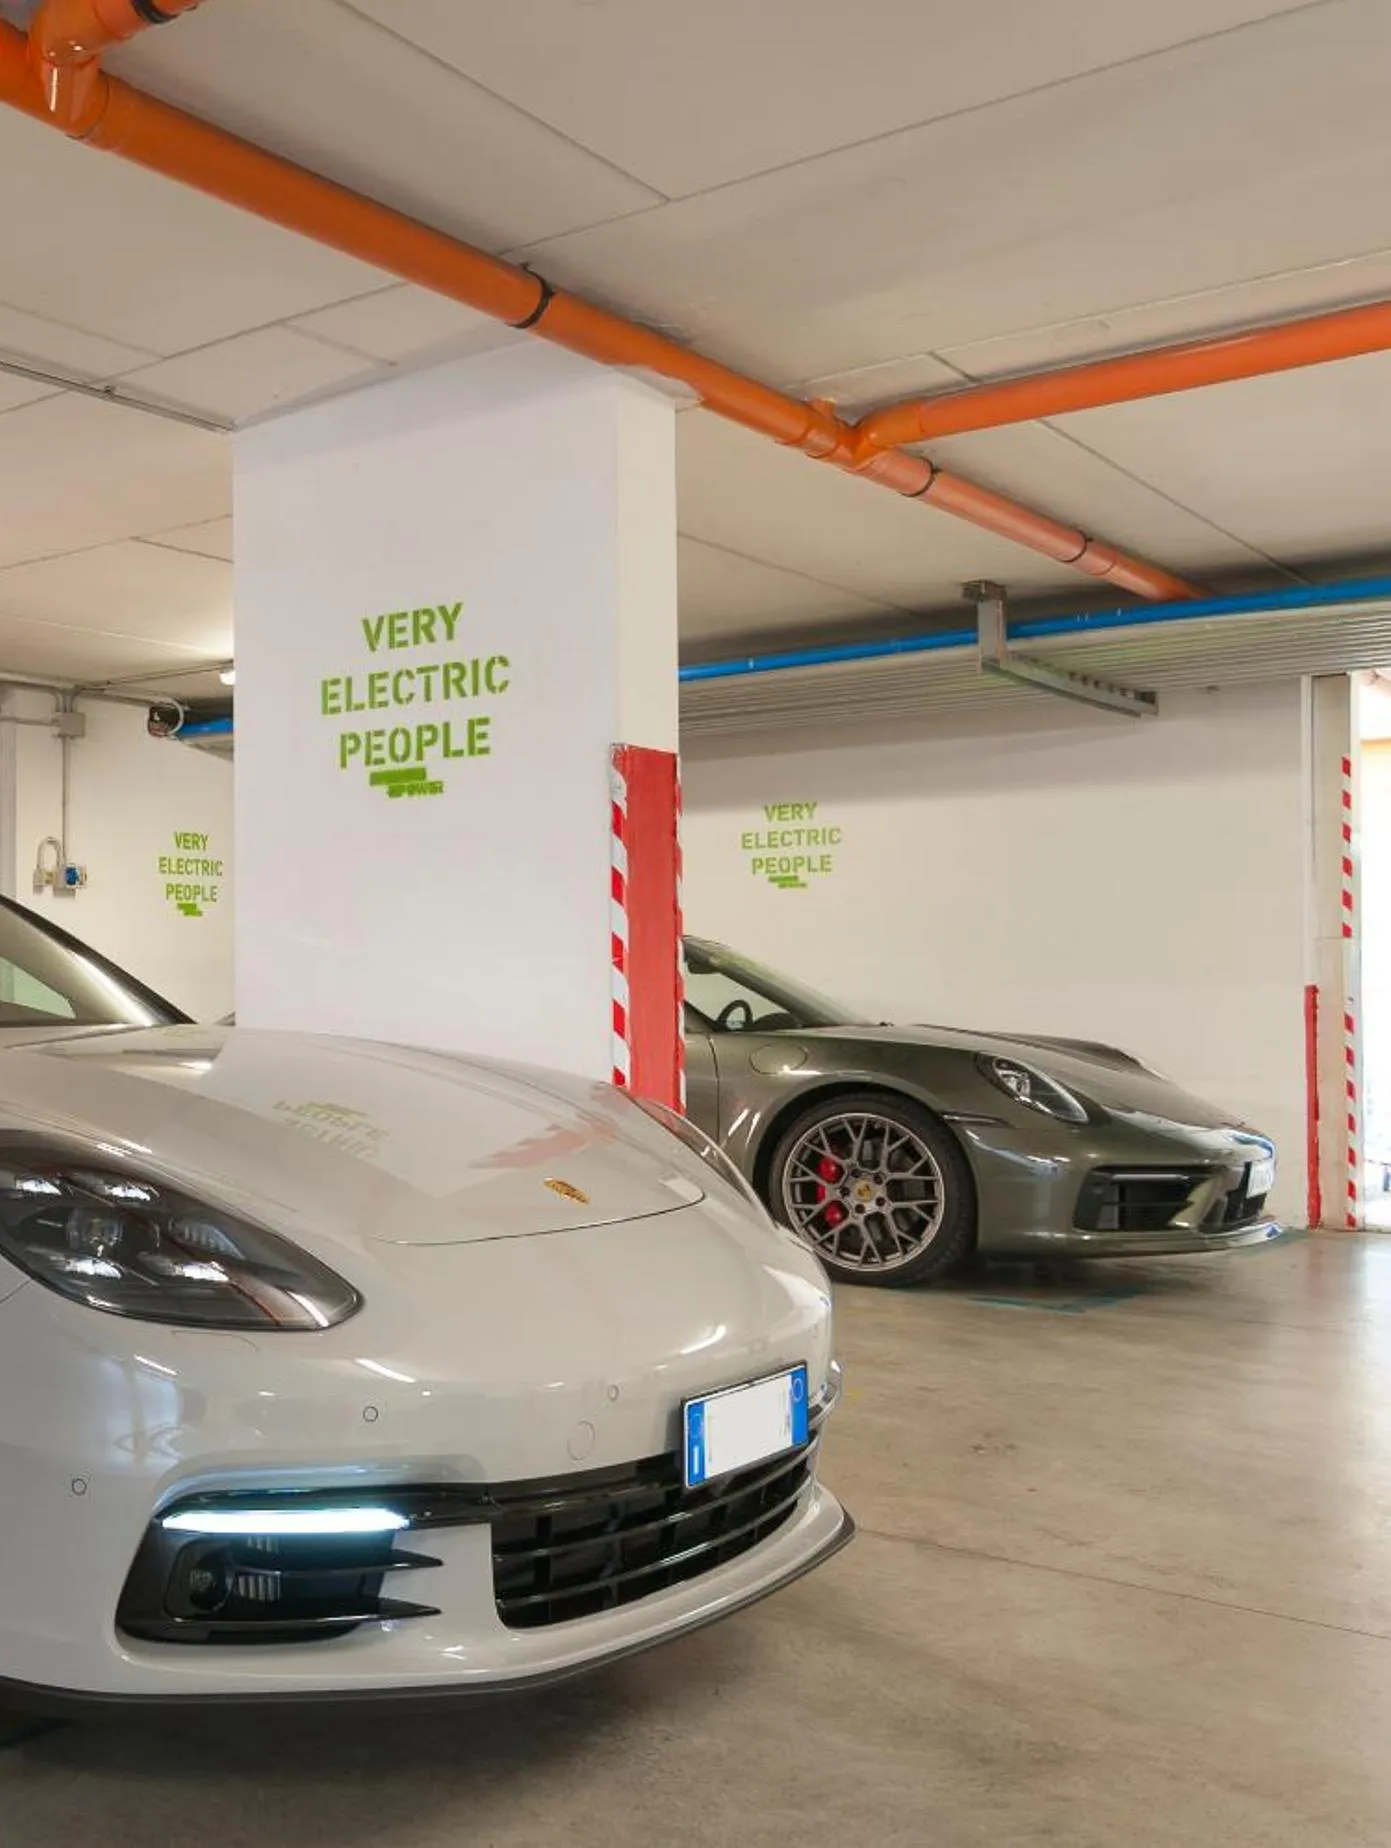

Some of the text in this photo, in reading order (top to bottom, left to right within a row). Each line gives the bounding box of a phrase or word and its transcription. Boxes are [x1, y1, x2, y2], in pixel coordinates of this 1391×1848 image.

[362, 602, 463, 652] VERY
[321, 656, 510, 715] ELECTRIC
[340, 717, 490, 768] PEOPLE
[764, 801, 817, 821] VERY
[174, 832, 209, 850] VERY
[741, 828, 842, 849] ELECTRIC
[158, 856, 223, 876] ELECTRIC
[752, 855, 832, 875] PEOPLE
[166, 884, 217, 902] PEOPLE
